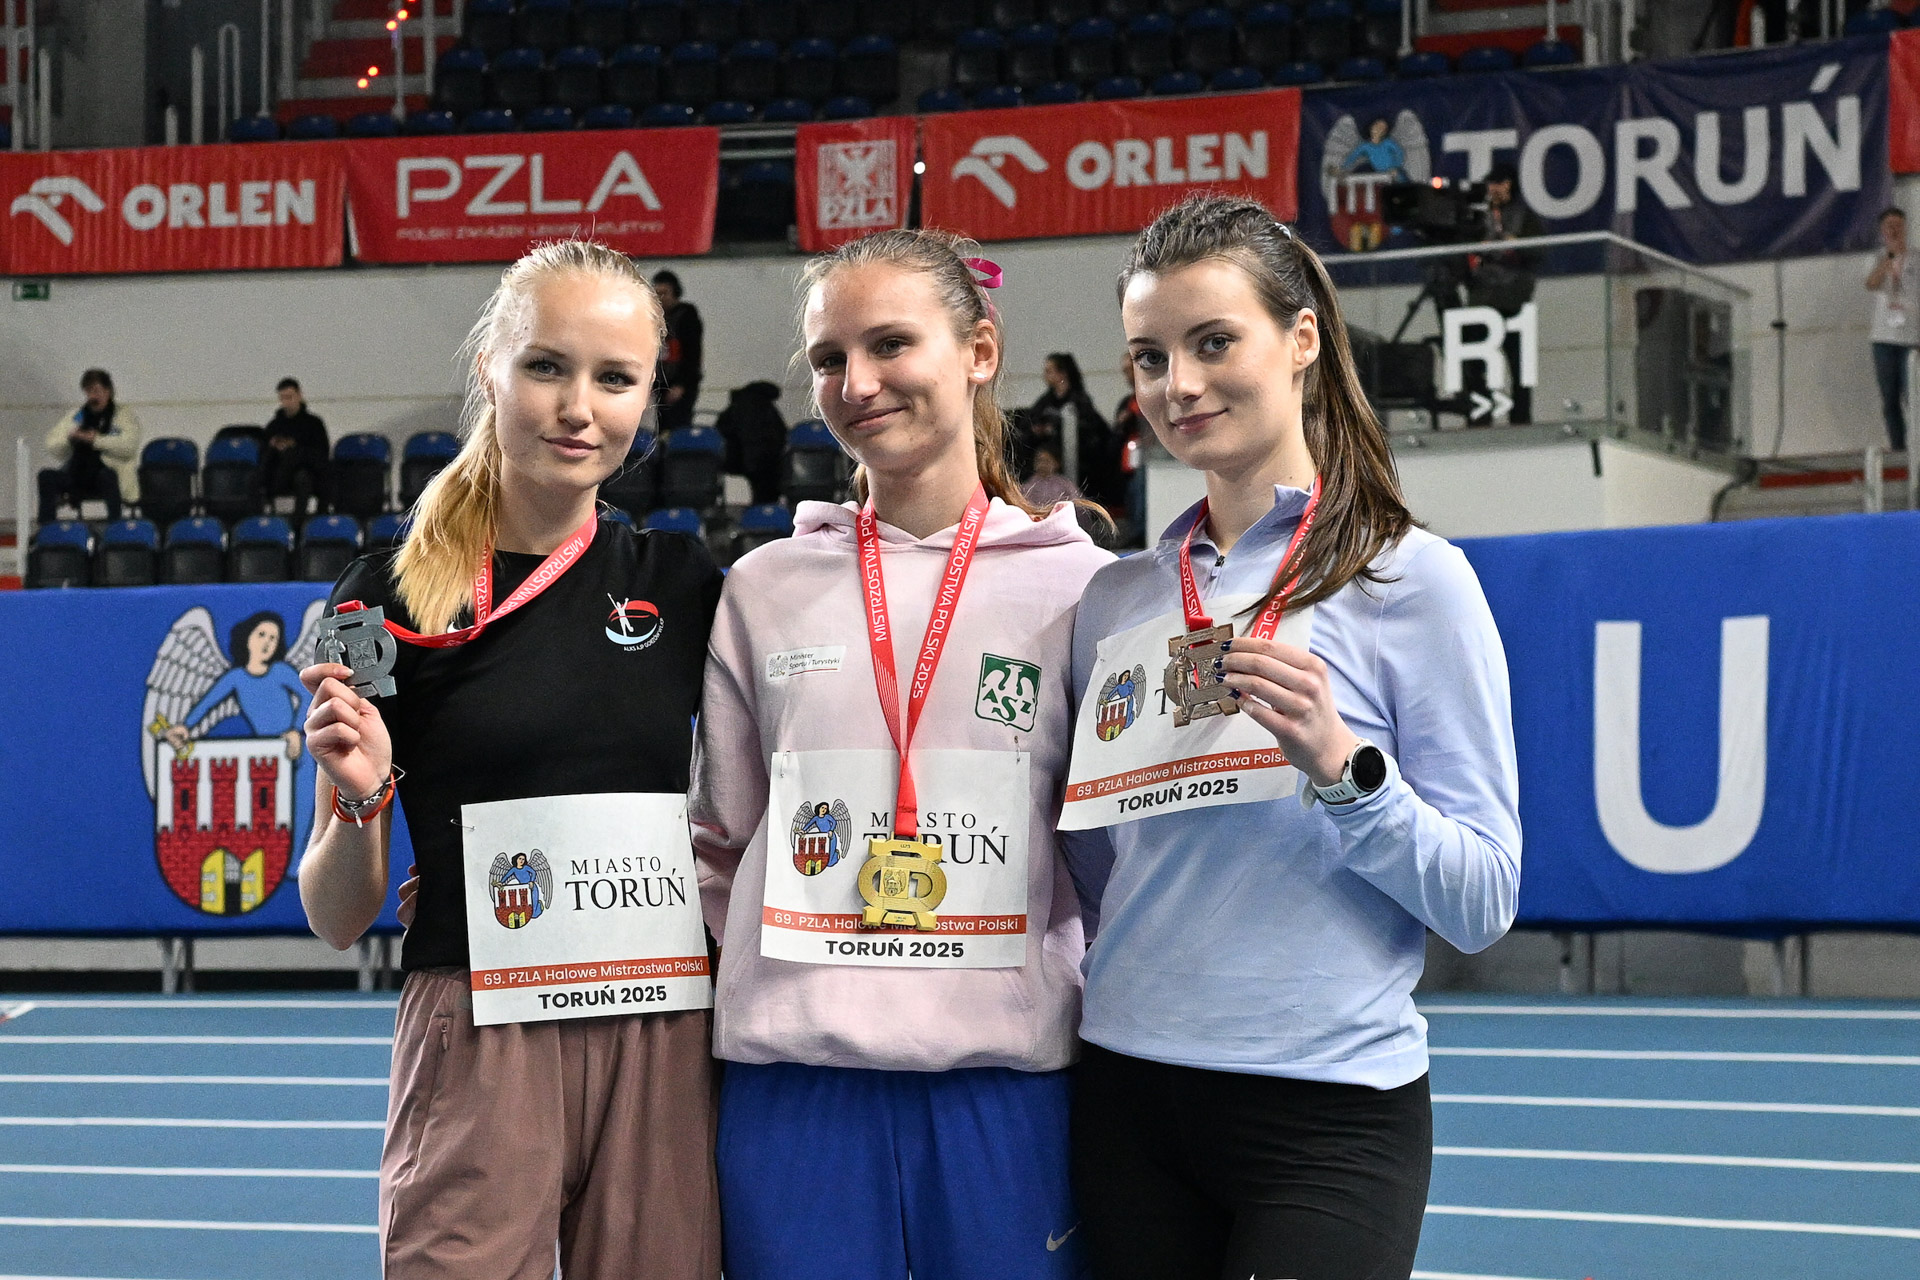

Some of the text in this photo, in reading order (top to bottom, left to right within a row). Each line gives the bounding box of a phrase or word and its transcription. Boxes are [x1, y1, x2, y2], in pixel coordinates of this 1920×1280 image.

[1066, 131, 1268, 191] ORLEN
[1443, 63, 1862, 220] TORUŃ
[122, 180, 316, 230] ORLEN
[397, 152, 662, 218] PZLA
[820, 196, 890, 225] PZLA
[1444, 302, 1539, 394] R1
[512, 536, 585, 601] MISTRZOSTWA
[864, 537, 887, 641] MISTRZOSTWA
[912, 507, 982, 699] MISTRZOSTWA POLSKI 2025
[1594, 616, 1770, 874] U
[1077, 785, 1095, 798] 69.
[1097, 778, 1124, 794] PZLA
[1126, 767, 1170, 787] Halowe
[1173, 755, 1251, 775] Mistrzostwa
[1118, 777, 1239, 814] TORUŃ 2025
[871, 811, 977, 829] MSTO
[571, 856, 662, 876] MIASTO
[564, 868, 687, 911] TORUŃ
[774, 911, 795, 926] 69.
[799, 916, 831, 929] PZLA
[979, 919, 1019, 931] Polski
[825, 938, 964, 958] TORUŃ 2025
[484, 959, 704, 986] 69. PZLA Halowe Mistrzostwa Polski
[538, 984, 668, 1010] TORUŃ 2025
